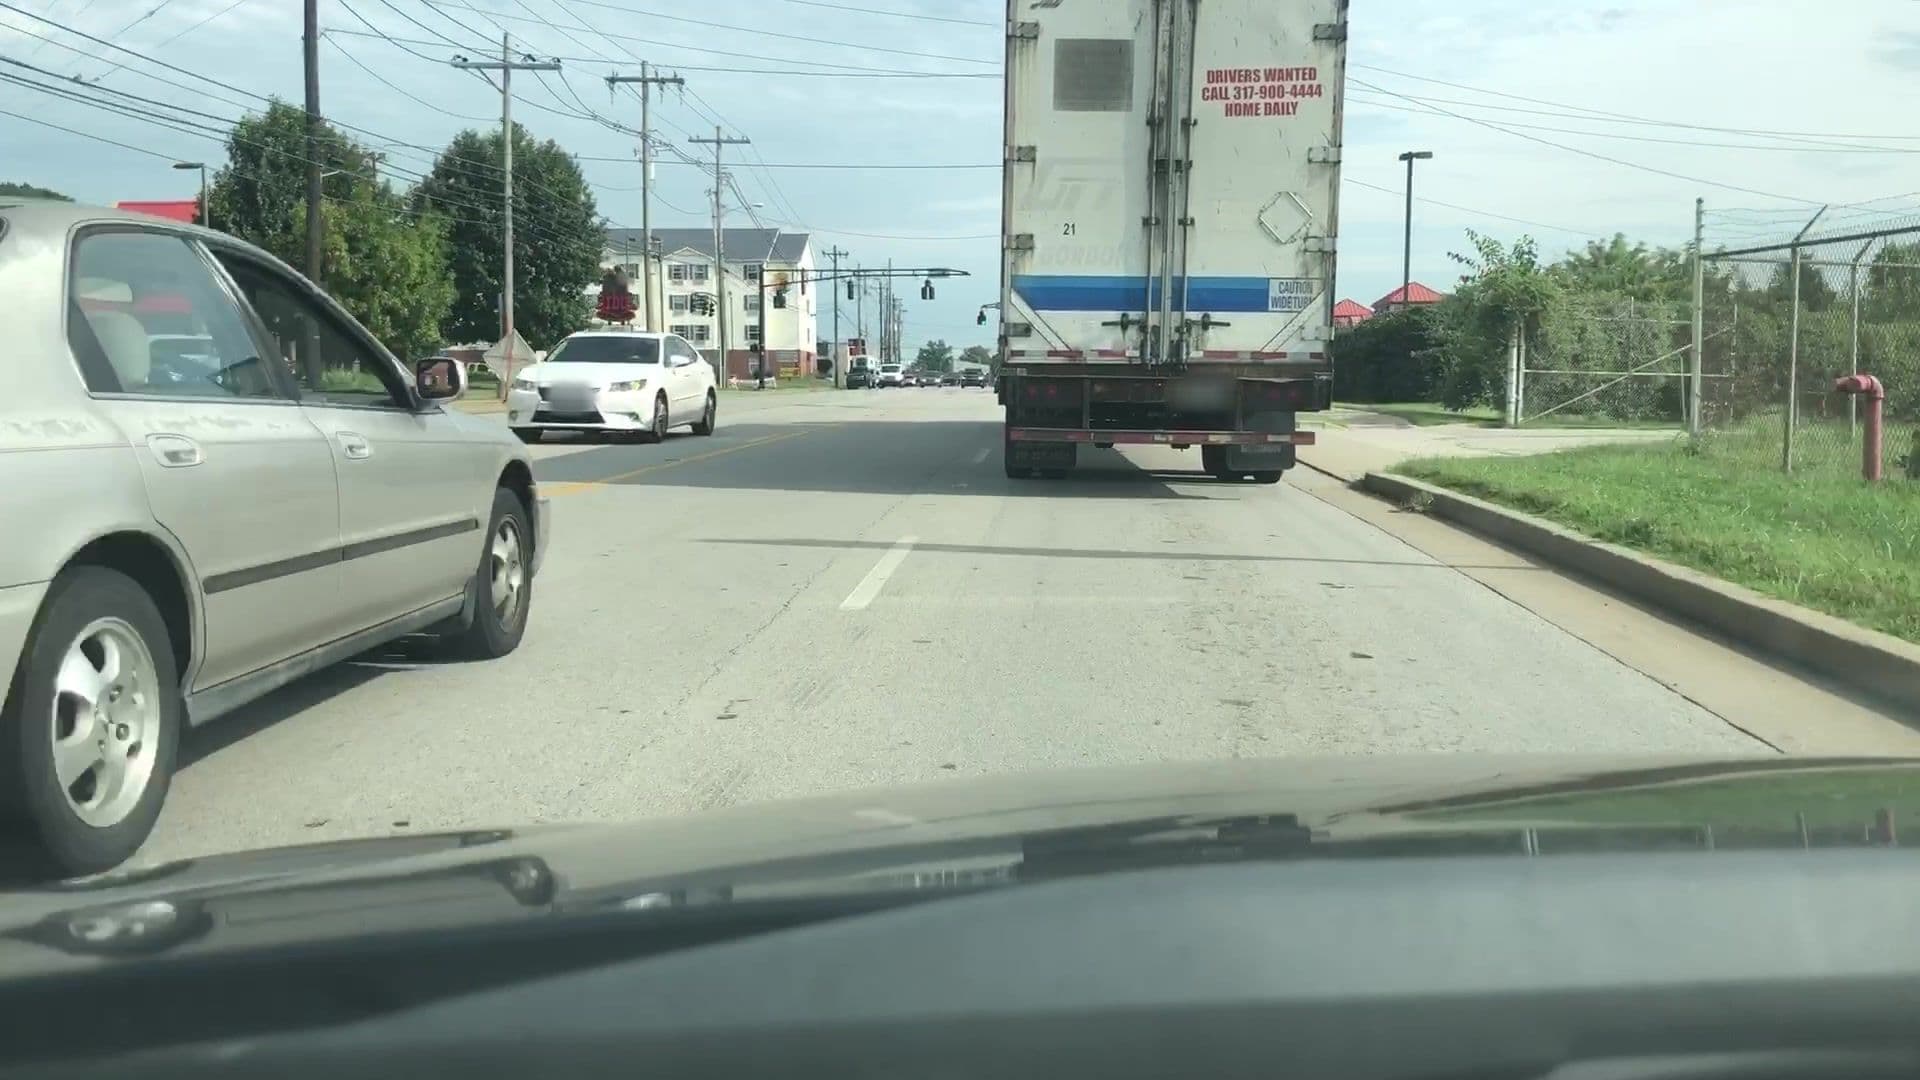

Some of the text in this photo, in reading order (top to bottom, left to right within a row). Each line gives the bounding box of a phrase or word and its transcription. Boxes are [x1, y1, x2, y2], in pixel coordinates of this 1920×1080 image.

[1206, 67, 1317, 84] DRIVERS WANTED
[1201, 84, 1322, 101] CALL 317-900-4444
[1225, 101, 1298, 117] HOME DAILY
[1063, 223, 1076, 236] 21
[1279, 281, 1313, 295] CAUTION
